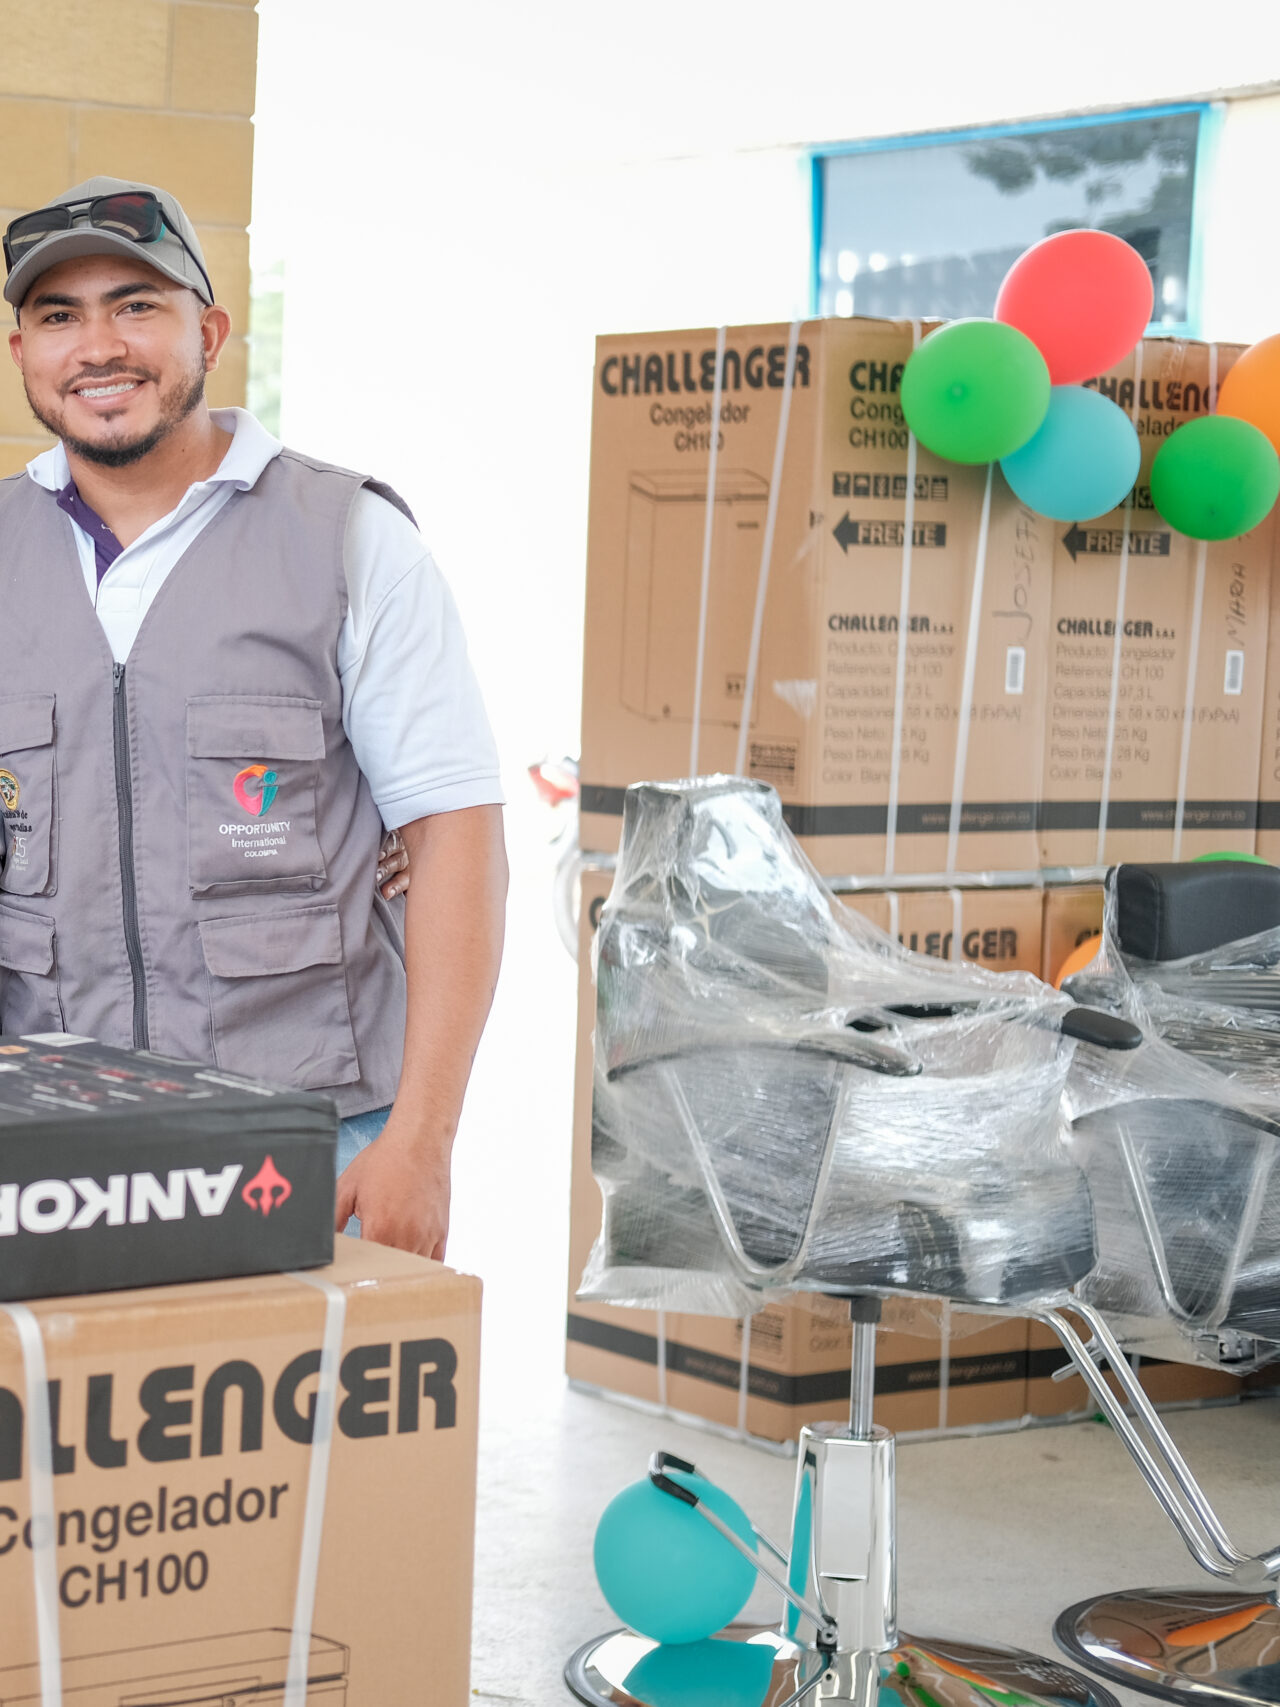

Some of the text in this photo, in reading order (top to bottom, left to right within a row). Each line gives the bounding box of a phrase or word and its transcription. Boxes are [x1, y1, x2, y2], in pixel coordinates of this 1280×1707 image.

[600, 344, 810, 396] CHALLENGER
[849, 360, 906, 393] CHA
[650, 401, 750, 428] Congeldor
[850, 396, 904, 426] Cong
[858, 525, 938, 545] FRENTE
[1087, 533, 1161, 553] FRENTE
[828, 614, 930, 633] CHALLENER
[219, 821, 291, 835] OPPORTUNITY
[58, 1549, 209, 1608] CH100
